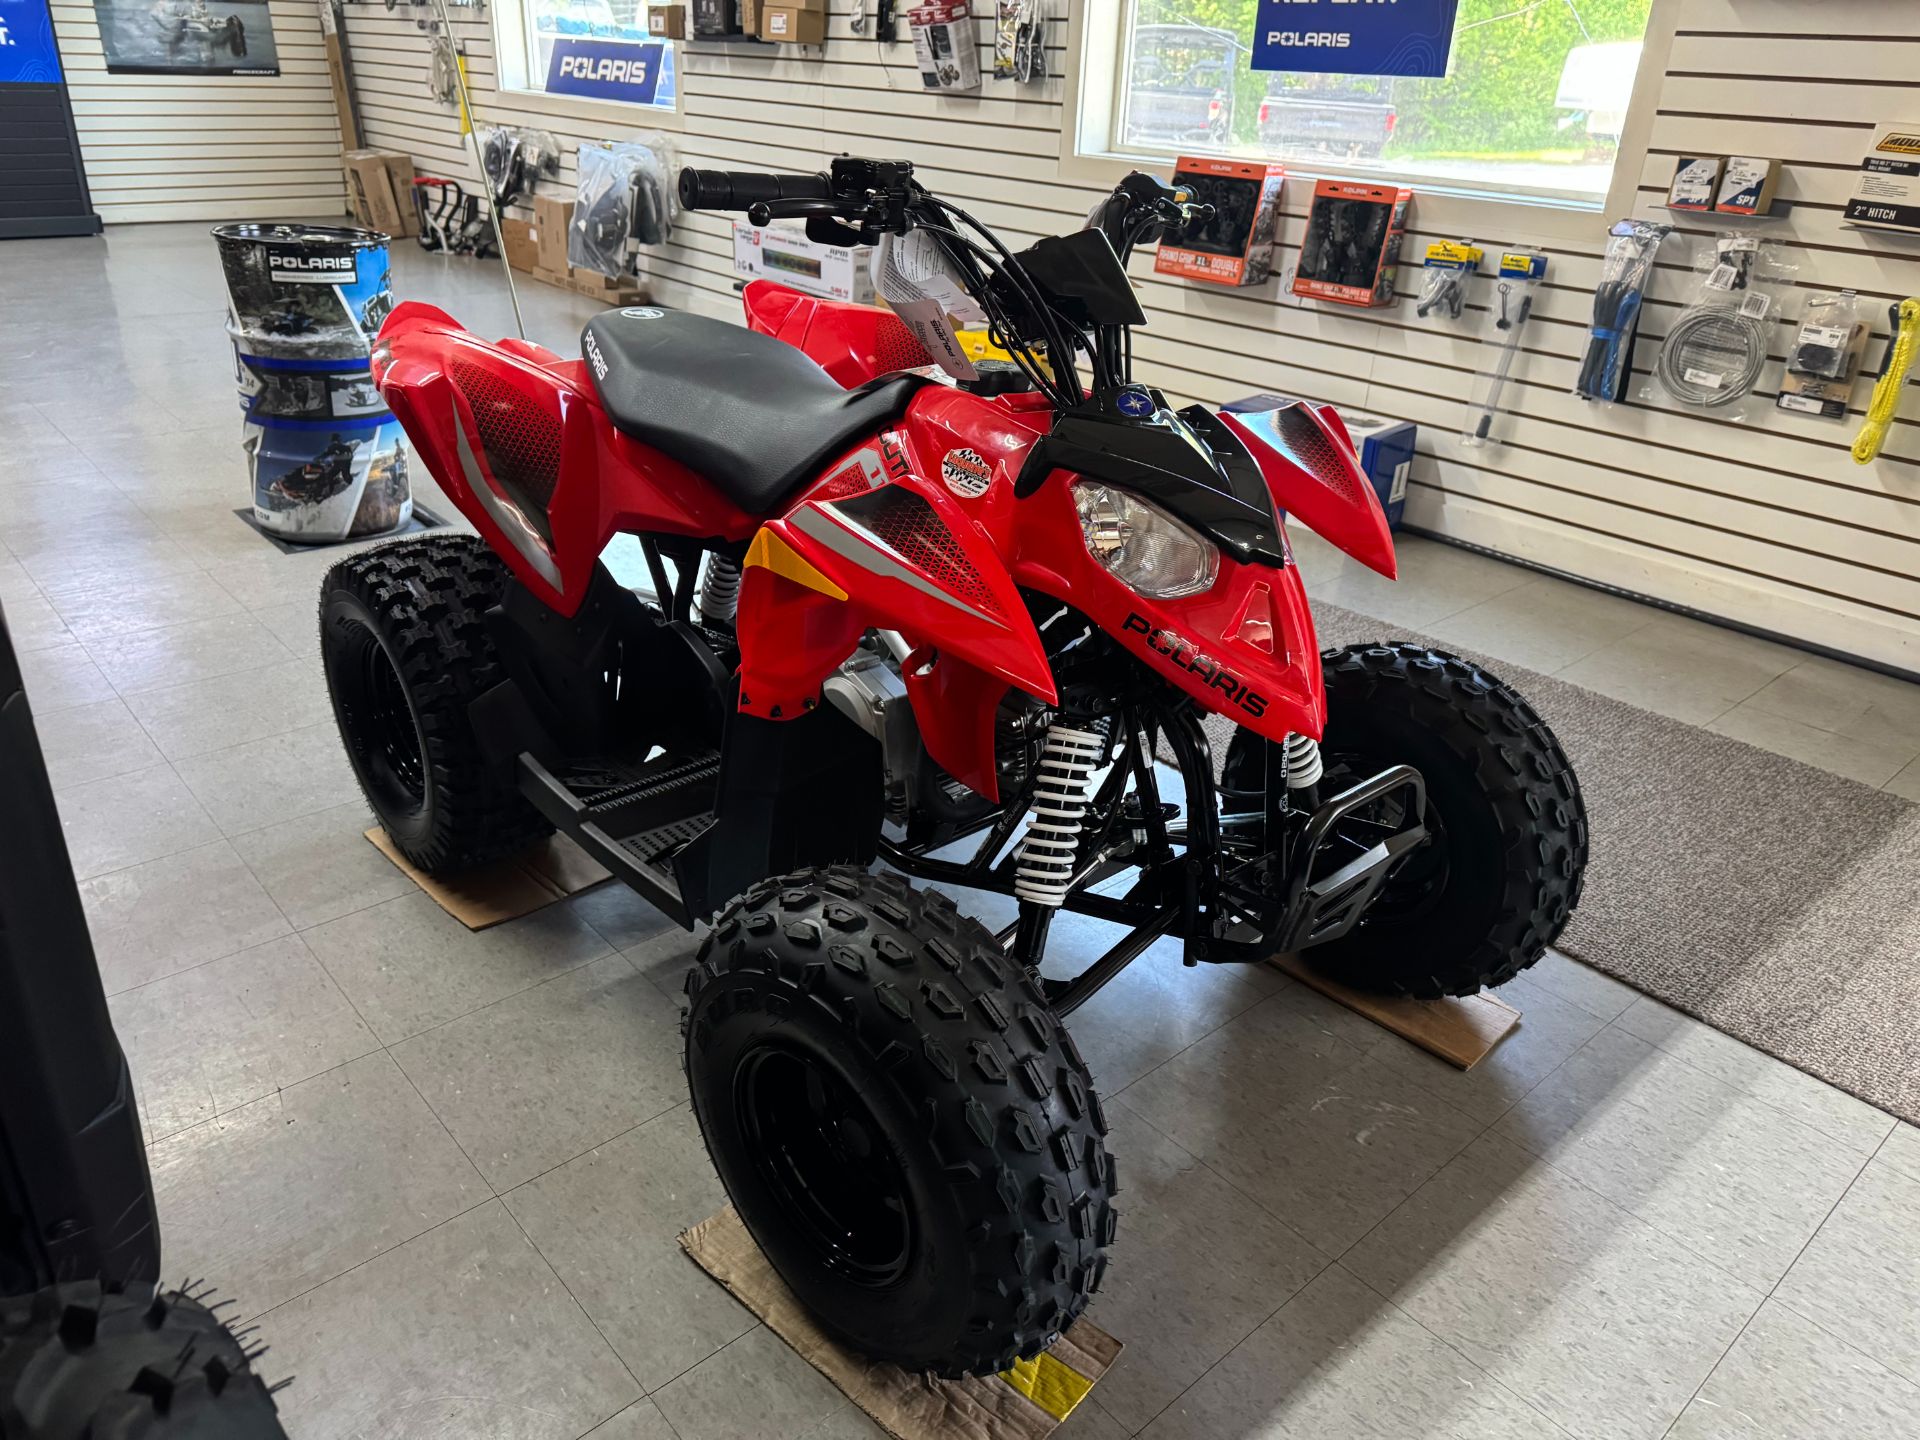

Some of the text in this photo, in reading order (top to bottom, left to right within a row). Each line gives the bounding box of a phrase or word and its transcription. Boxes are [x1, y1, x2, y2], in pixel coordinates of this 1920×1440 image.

[1266, 31, 1350, 47] POLARIS
[560, 56, 647, 84] POLARIS
[1735, 195, 1756, 206] SP1
[1868, 207, 1897, 220] HITCH
[269, 256, 353, 269] POLARIS
[1211, 257, 1240, 273] DOUBLE
[585, 329, 608, 381] POLARIS
[1121, 611, 1270, 719] POLARIS
